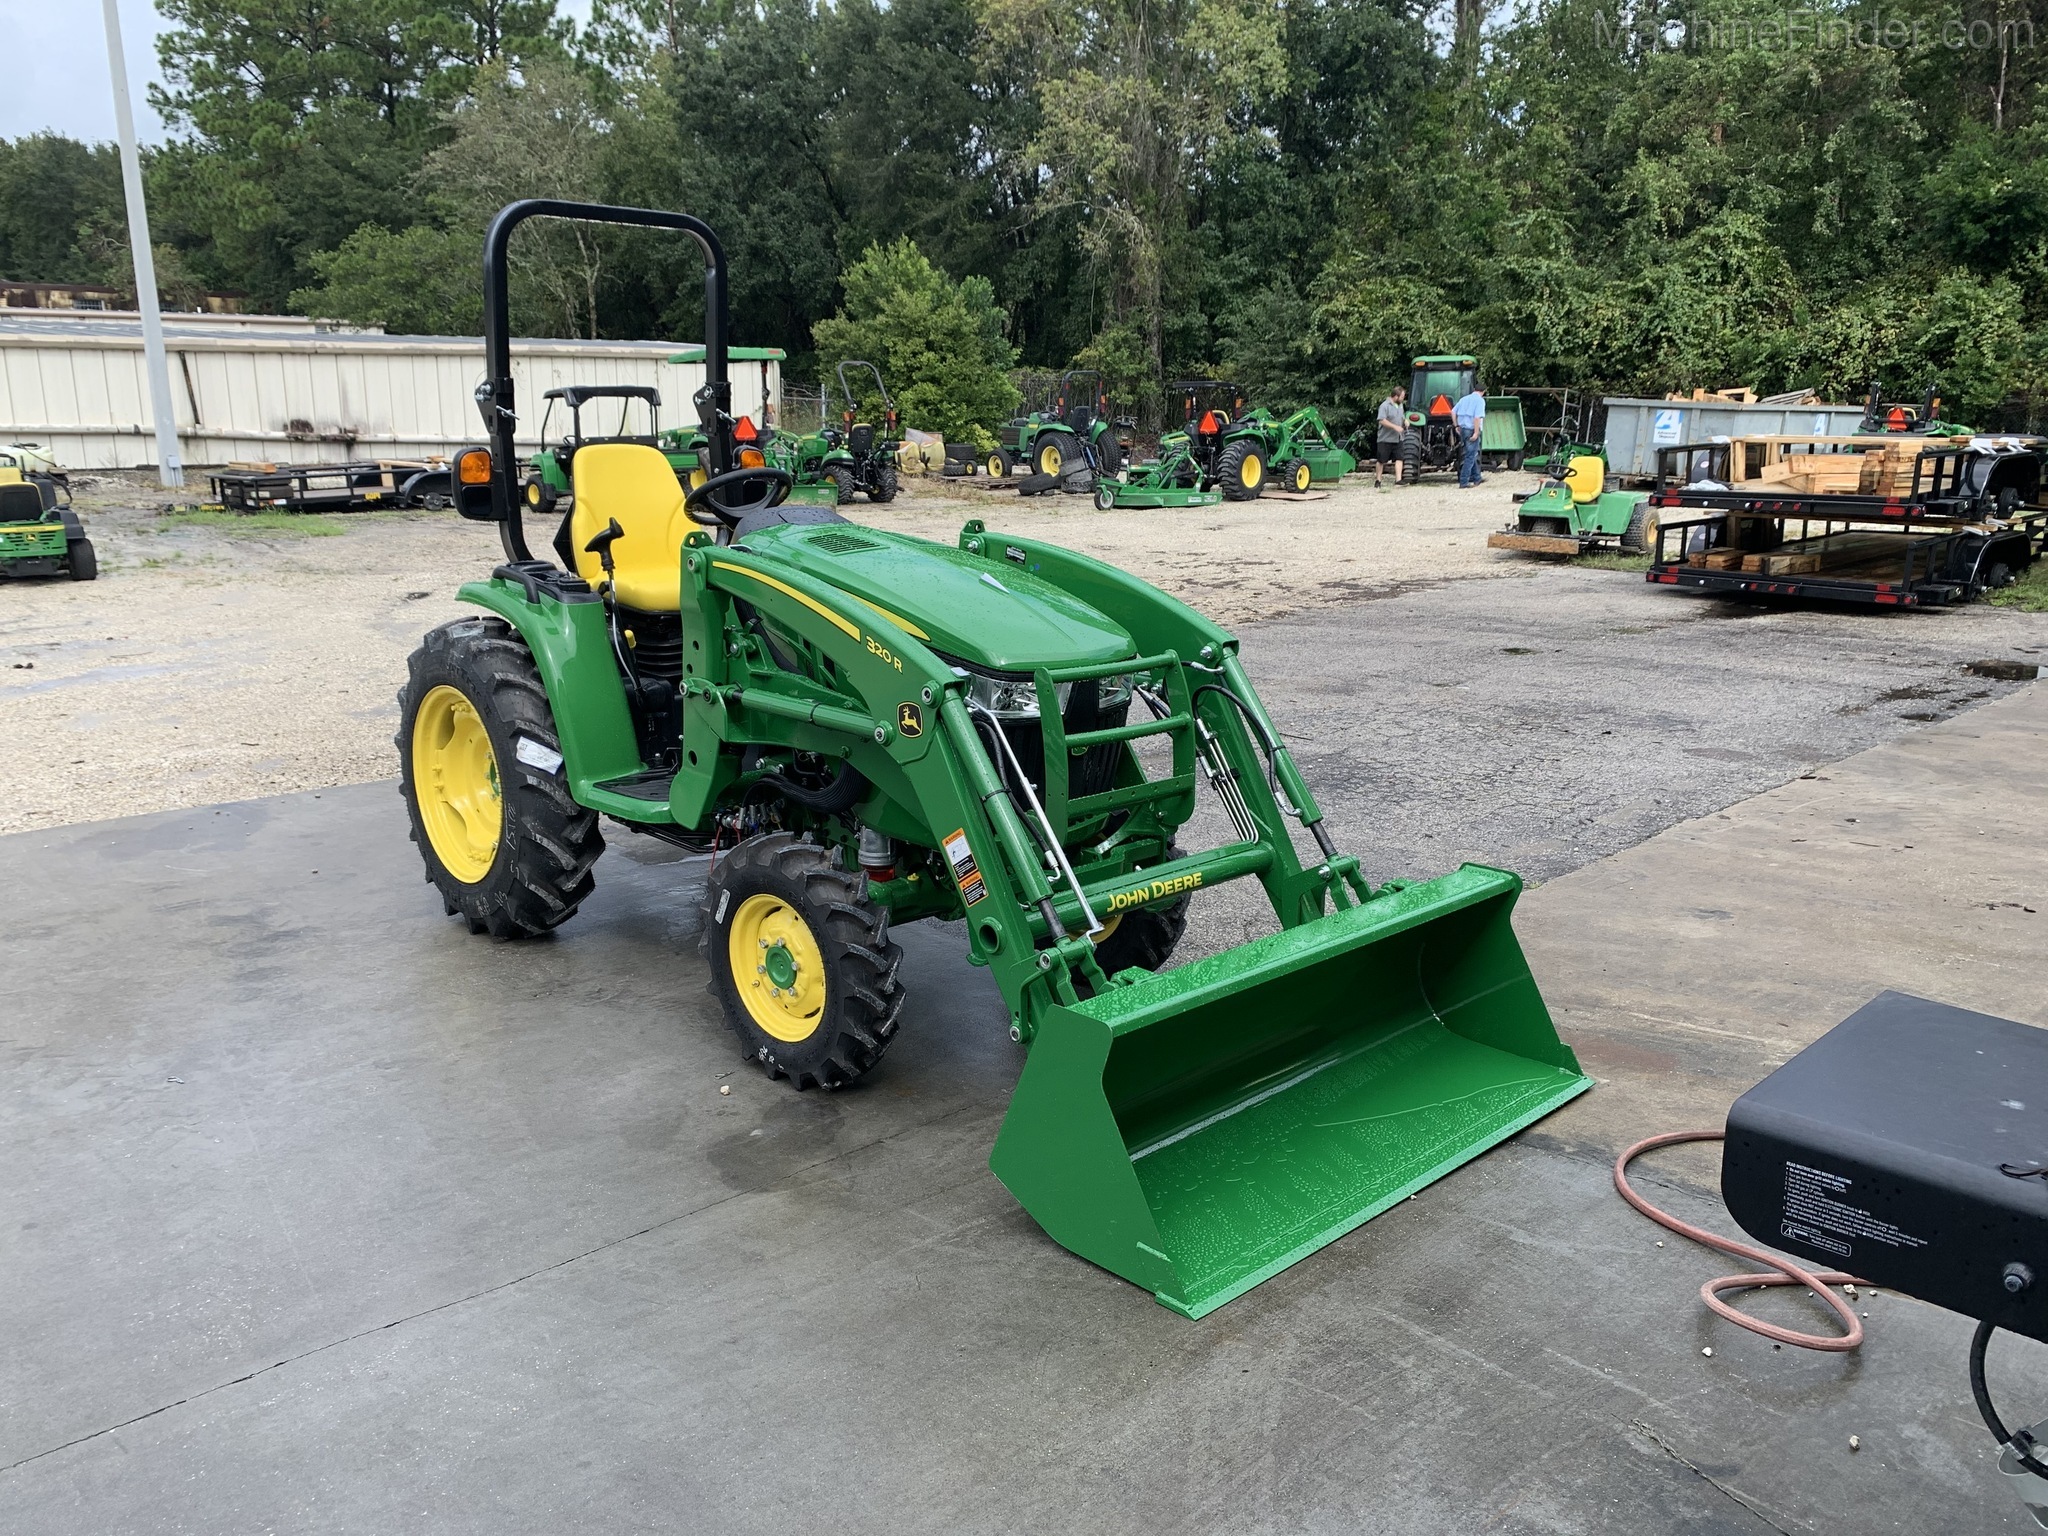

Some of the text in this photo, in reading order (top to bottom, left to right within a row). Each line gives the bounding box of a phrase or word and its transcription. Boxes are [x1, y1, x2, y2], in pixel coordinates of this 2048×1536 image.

[866, 635, 903, 674] 320 R
[1106, 872, 1203, 913] JOHN DEERE
